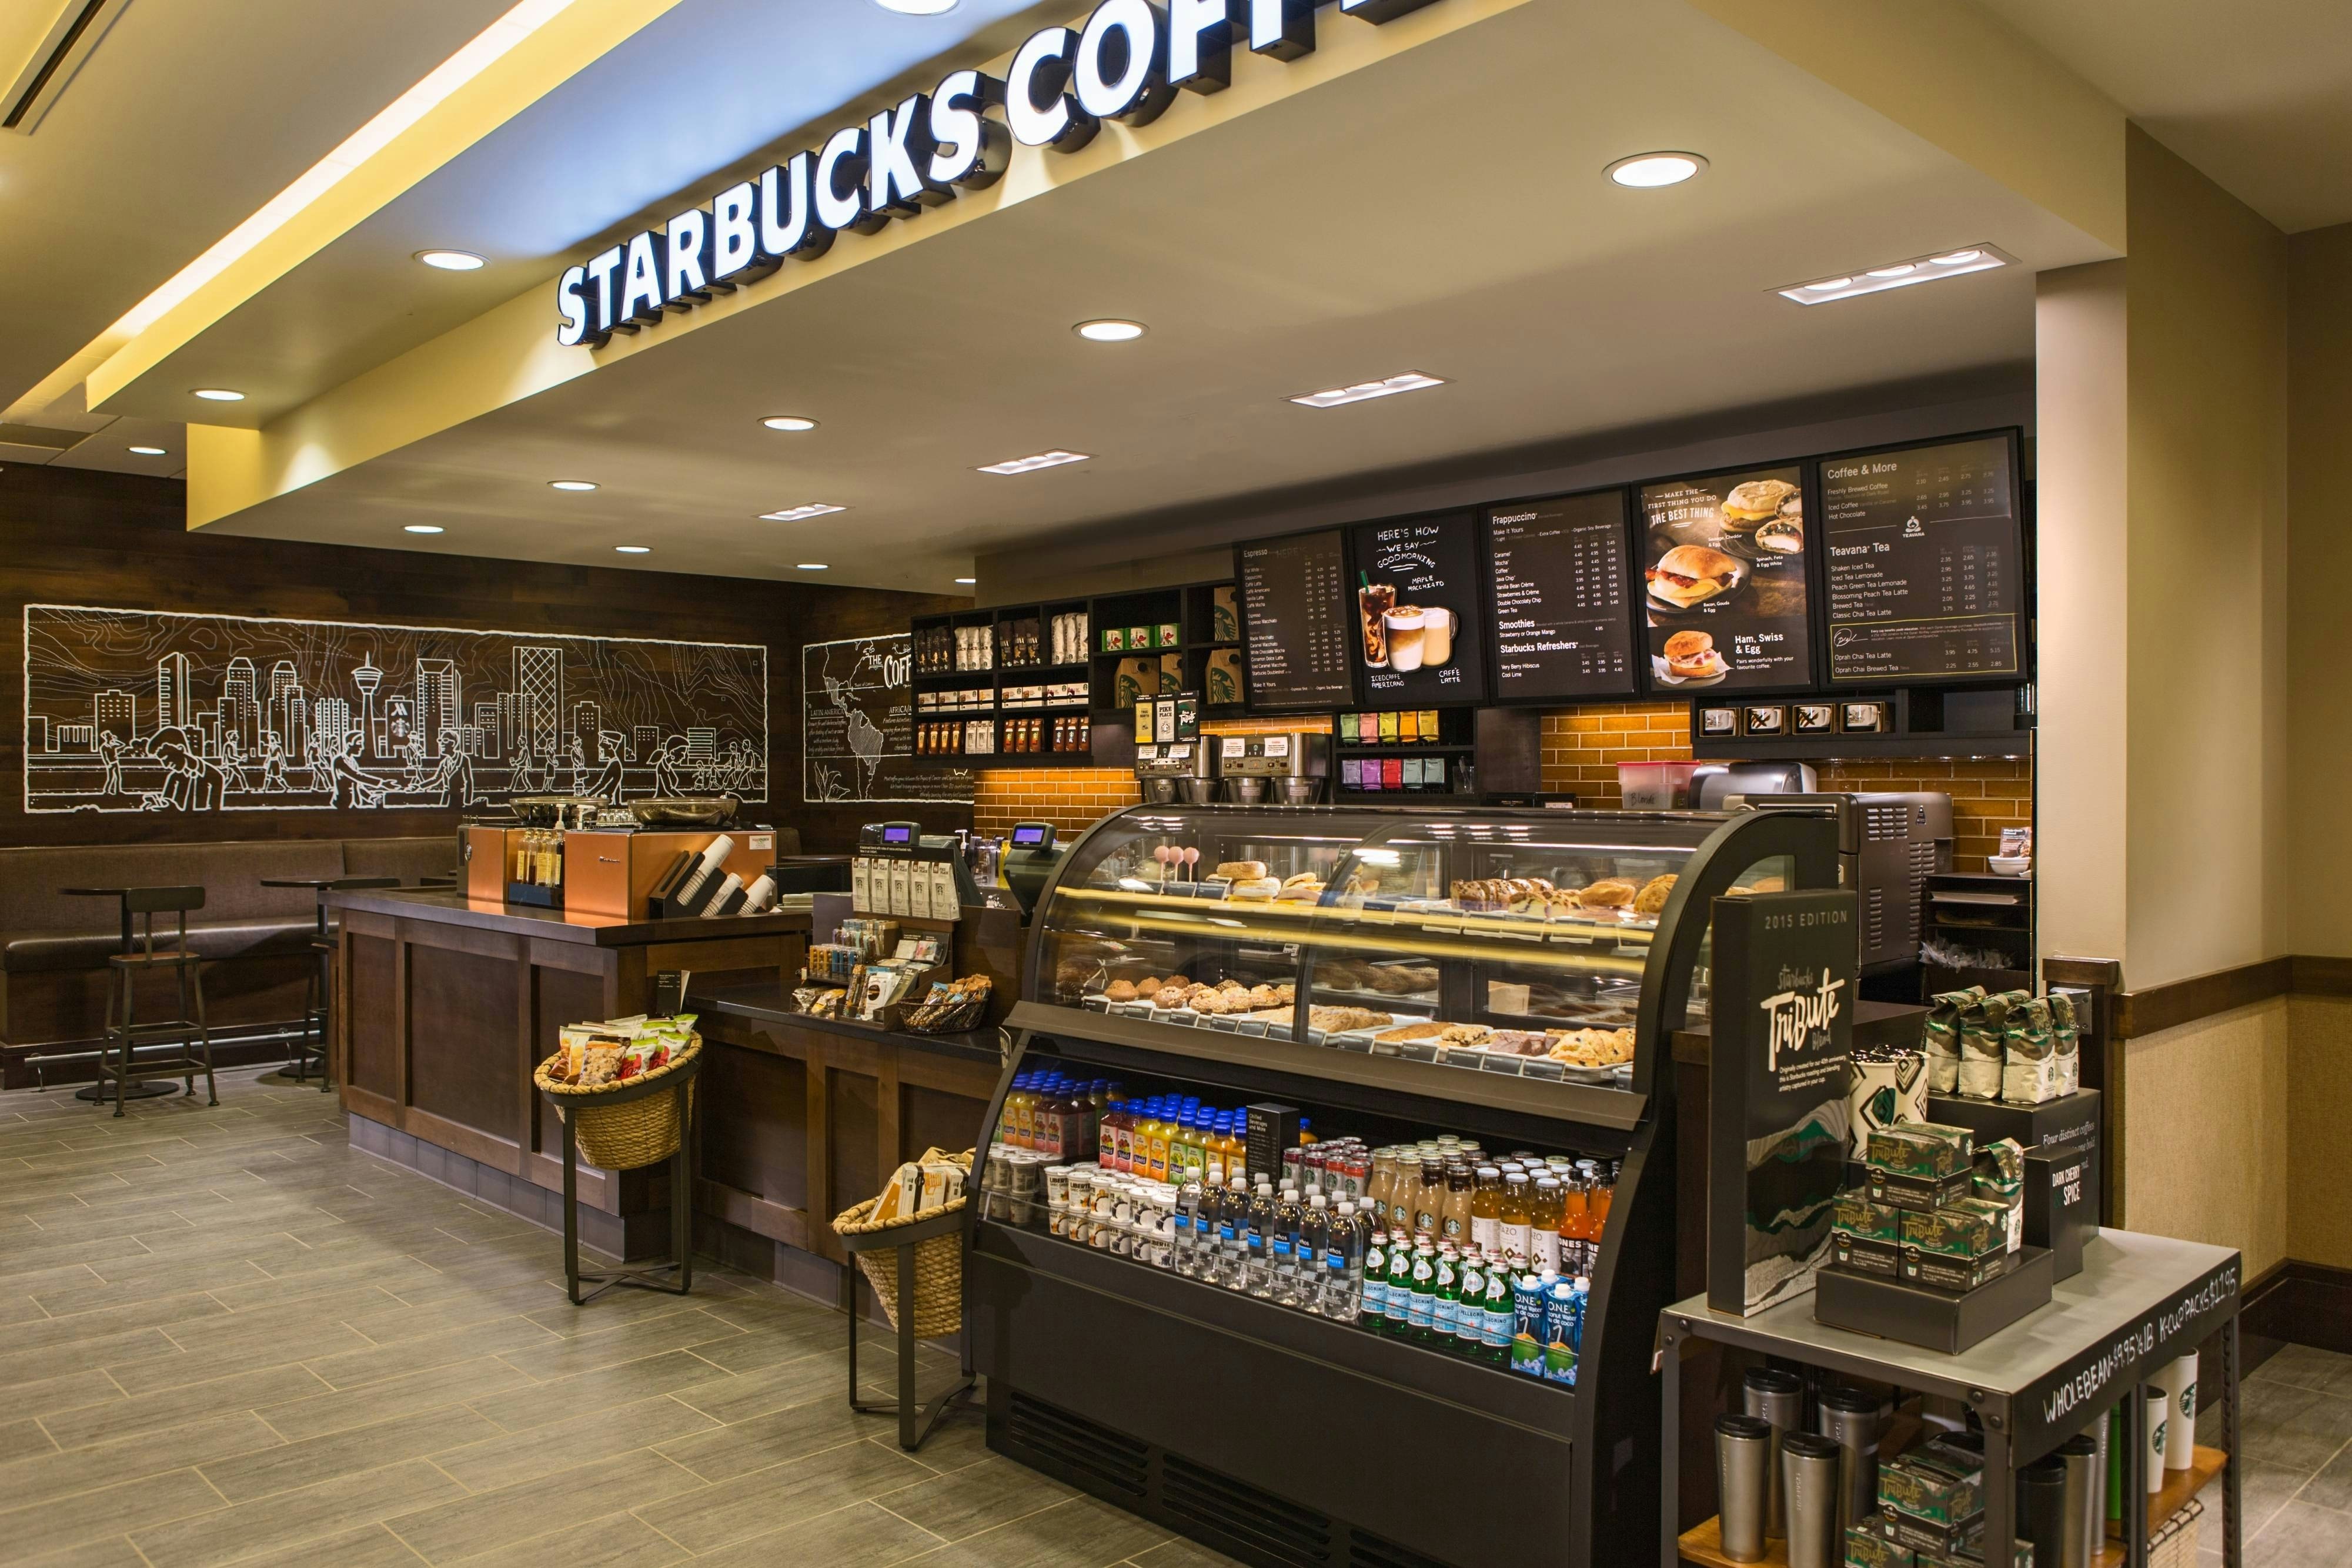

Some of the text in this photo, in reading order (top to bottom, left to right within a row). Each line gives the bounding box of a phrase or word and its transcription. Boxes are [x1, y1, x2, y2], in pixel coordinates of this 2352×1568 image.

[557, 69, 980, 347] STARBUCKS
[1828, 463, 1897, 479] Coffee & More
[1848, 484, 1867, 493] Brewed
[1665, 490, 1684, 499] MAKE
[1648, 501, 1666, 509] FIRST
[1668, 499, 1689, 507] THING
[1651, 507, 1714, 526] THE BEST THING
[1378, 527, 1439, 541] HERE'S HOW
[1387, 541, 1419, 553] WE SAY
[1873, 542, 1890, 552] Tea
[1244, 549, 1267, 559] Espresso
[1412, 575, 1434, 584] MAPLE
[1408, 581, 1444, 591] MACCHIATO
[1499, 619, 1535, 630] Smoothies
[1735, 633, 1783, 644] Ham, Swiss
[1501, 643, 1535, 653] Starbucks
[1736, 645, 1761, 655] & Egg
[869, 654, 881, 665] THE
[1765, 911, 1847, 930] 2015 EDITION
[2043, 1134, 2058, 1145] Four
[2059, 1128, 2079, 1142] distinct
[2052, 1165, 2080, 1187] DARK CHERRY
[2064, 1181, 2080, 1206] SPICE
[1515, 1293, 1536, 1306] O.N.E.
[1548, 1302, 1570, 1314] O.N.E.
